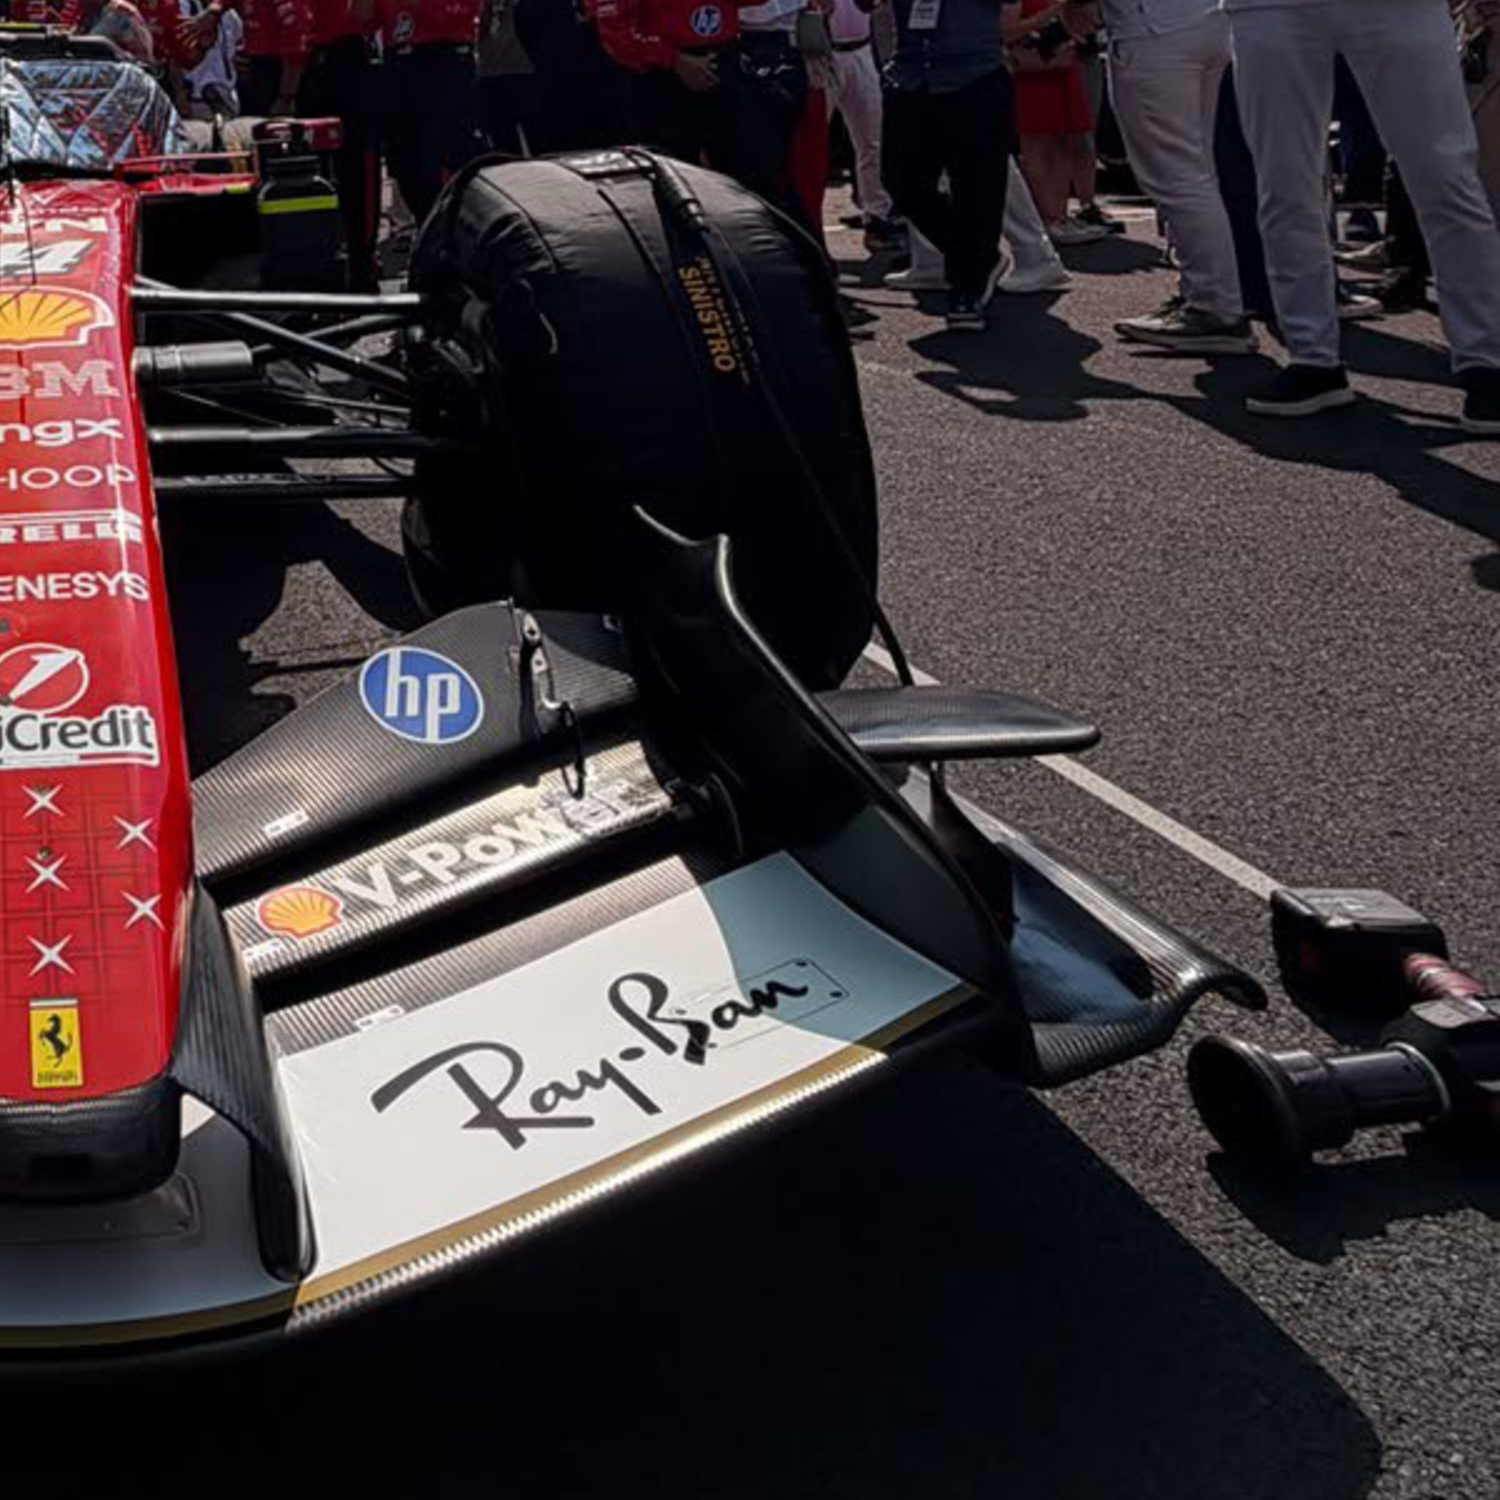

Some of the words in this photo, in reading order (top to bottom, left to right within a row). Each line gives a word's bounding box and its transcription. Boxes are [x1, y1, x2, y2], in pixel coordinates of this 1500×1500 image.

[678, 265, 737, 372] SINISTRO
[384, 647, 461, 743] hp
[333, 776, 633, 904] V-Power
[370, 972, 809, 1151] Ray-Ban
